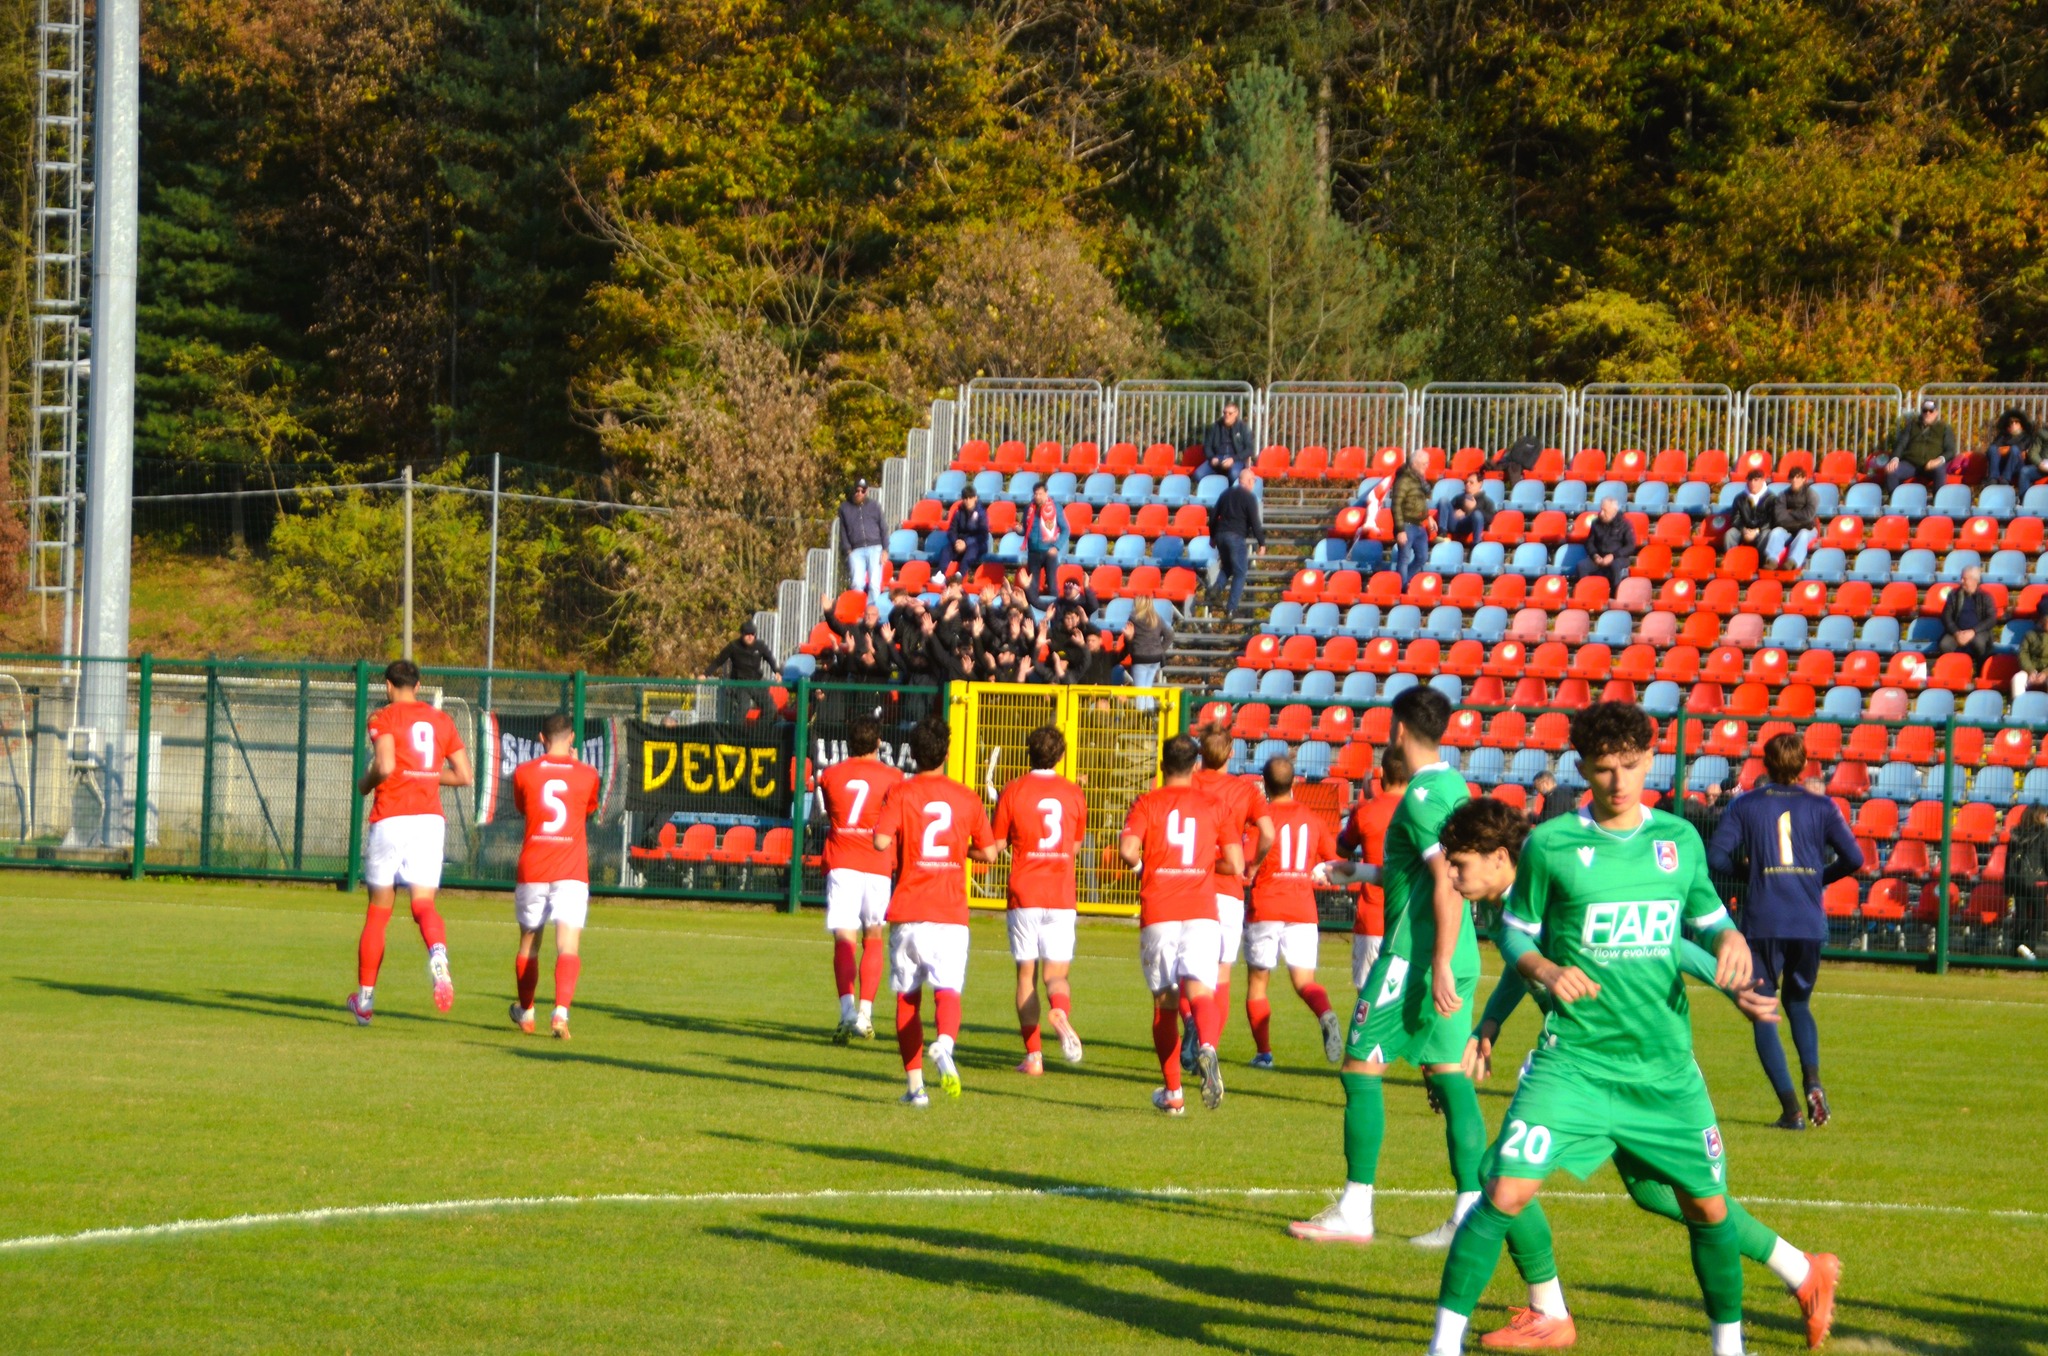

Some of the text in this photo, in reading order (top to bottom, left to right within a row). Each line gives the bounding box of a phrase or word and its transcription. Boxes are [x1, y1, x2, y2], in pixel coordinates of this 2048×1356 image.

[412, 721, 434, 769] 9
[643, 740, 777, 797] DEDE
[543, 779, 568, 833] 5
[845, 779, 869, 826] 7
[1037, 797, 1062, 848] 3
[922, 801, 952, 857] 2
[1167, 809, 1196, 865] 4
[1281, 823, 1308, 870] 11
[1777, 810, 1793, 866] 1
[1594, 947, 1620, 958] flow
[1500, 1119, 1551, 1164] 20
